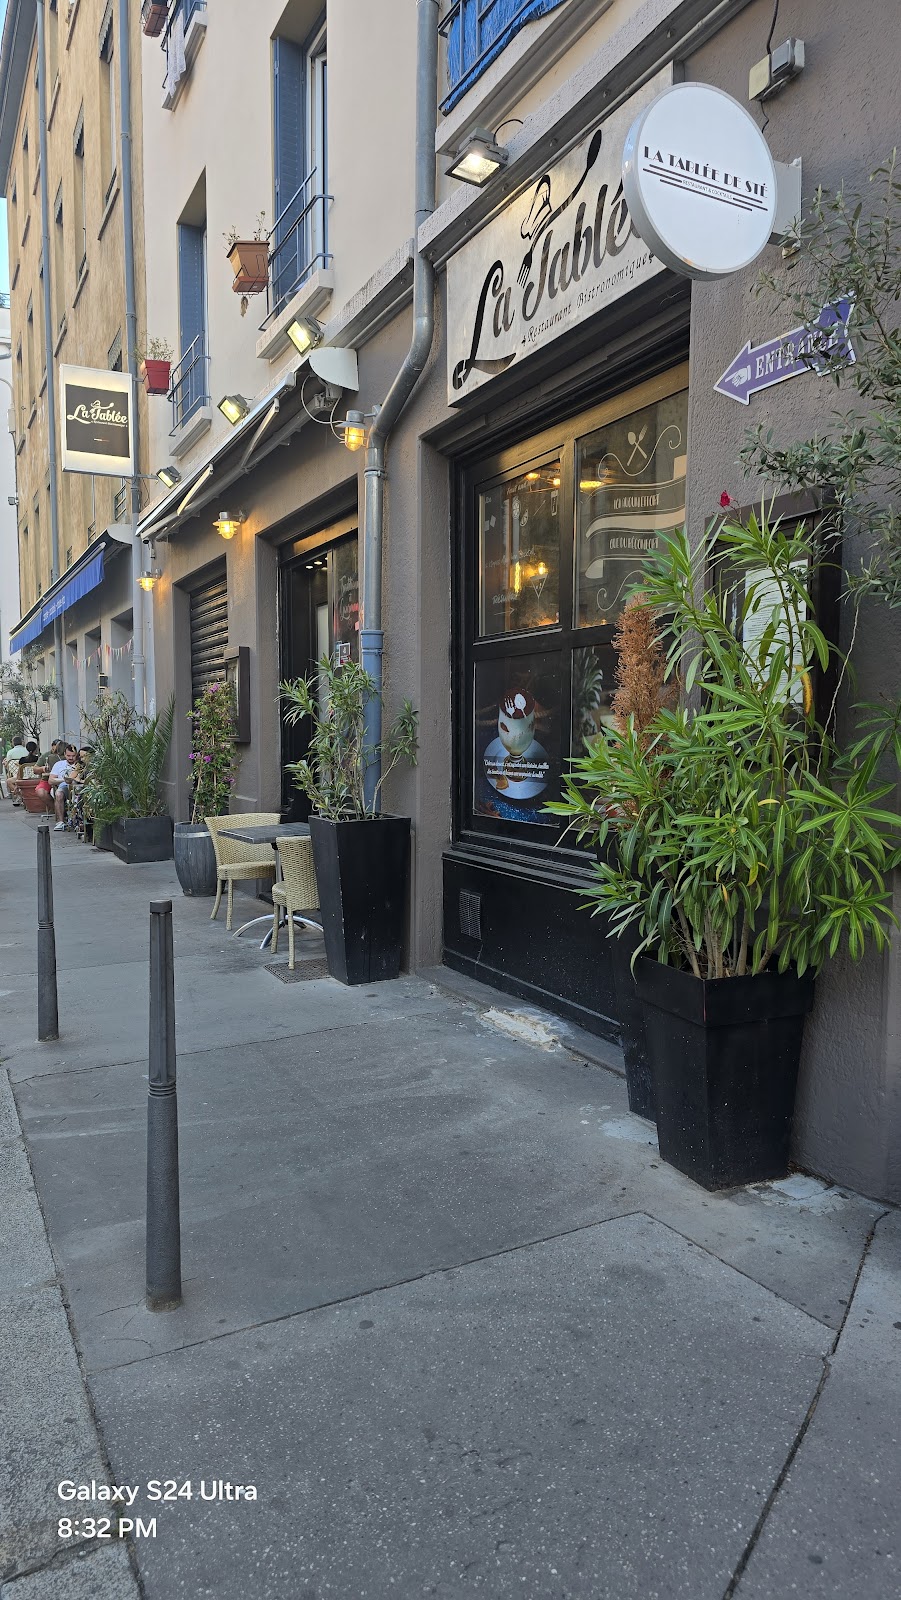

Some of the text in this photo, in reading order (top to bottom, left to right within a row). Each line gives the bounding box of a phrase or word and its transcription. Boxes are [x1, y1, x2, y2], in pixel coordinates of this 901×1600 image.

[644, 146, 768, 198] LA TABLÉE DE STÉ
[453, 178, 642, 390] La Tablé
[527, 303, 572, 342] Restaurant
[67, 404, 91, 424] La
[91, 407, 128, 424] Tablée
